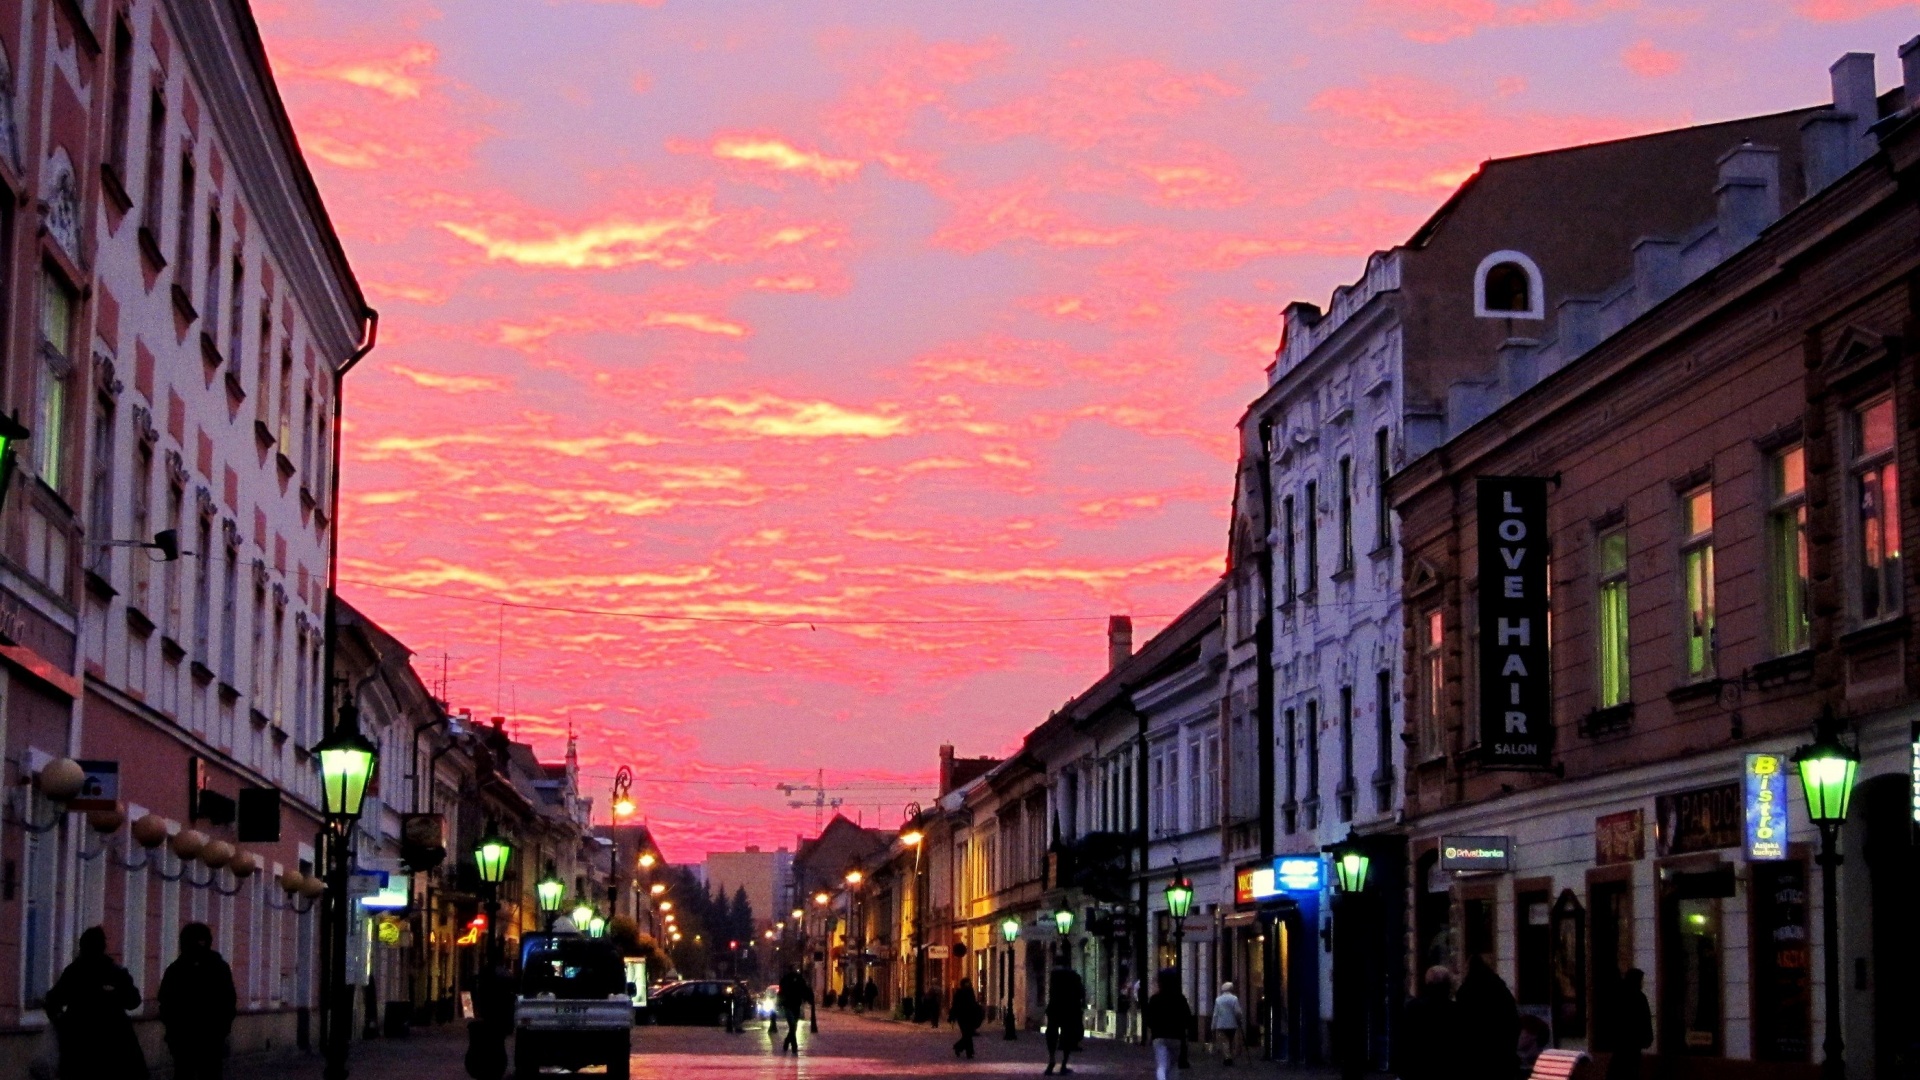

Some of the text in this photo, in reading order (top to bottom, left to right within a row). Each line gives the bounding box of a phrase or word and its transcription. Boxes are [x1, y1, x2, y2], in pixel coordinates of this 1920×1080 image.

[1497, 490, 1531, 734] LOVE HAIR
[1494, 743, 1538, 756] SALON
[1754, 756, 1778, 839] Bistro
